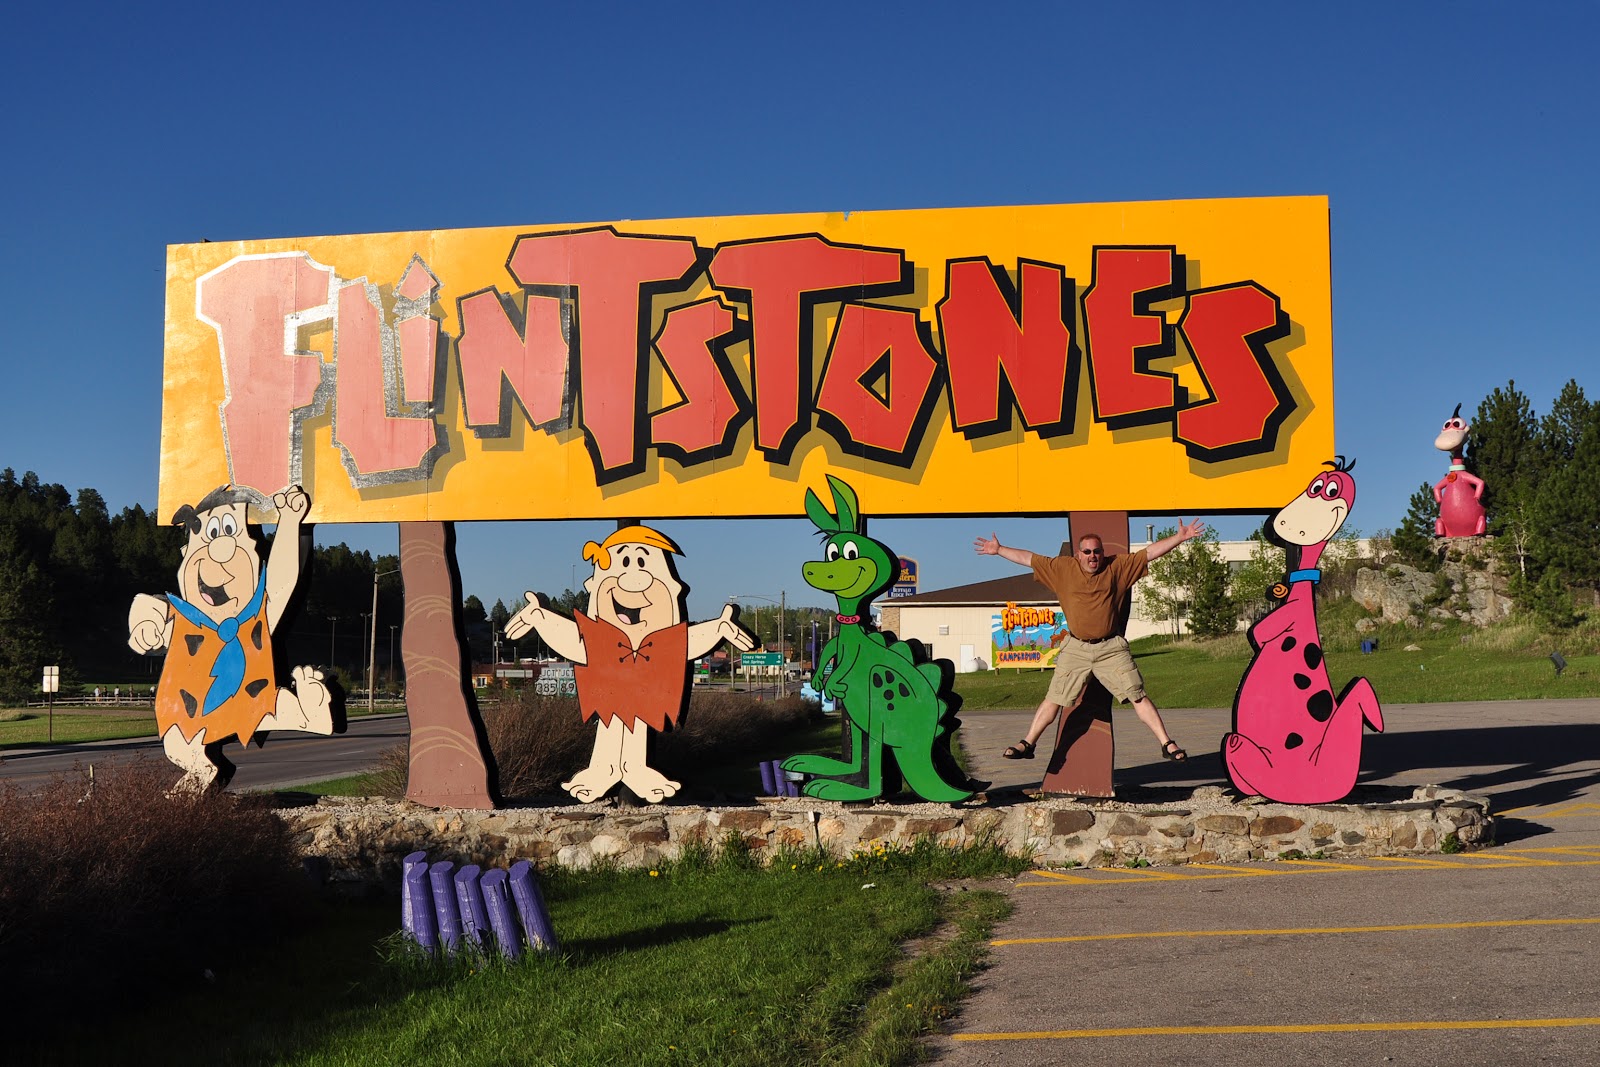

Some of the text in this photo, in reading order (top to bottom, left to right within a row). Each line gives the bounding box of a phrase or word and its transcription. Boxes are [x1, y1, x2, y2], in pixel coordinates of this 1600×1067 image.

[1000, 651, 1041, 662] CAMPGROUND
[536, 683, 556, 692] 385
[561, 683, 575, 692] 89
